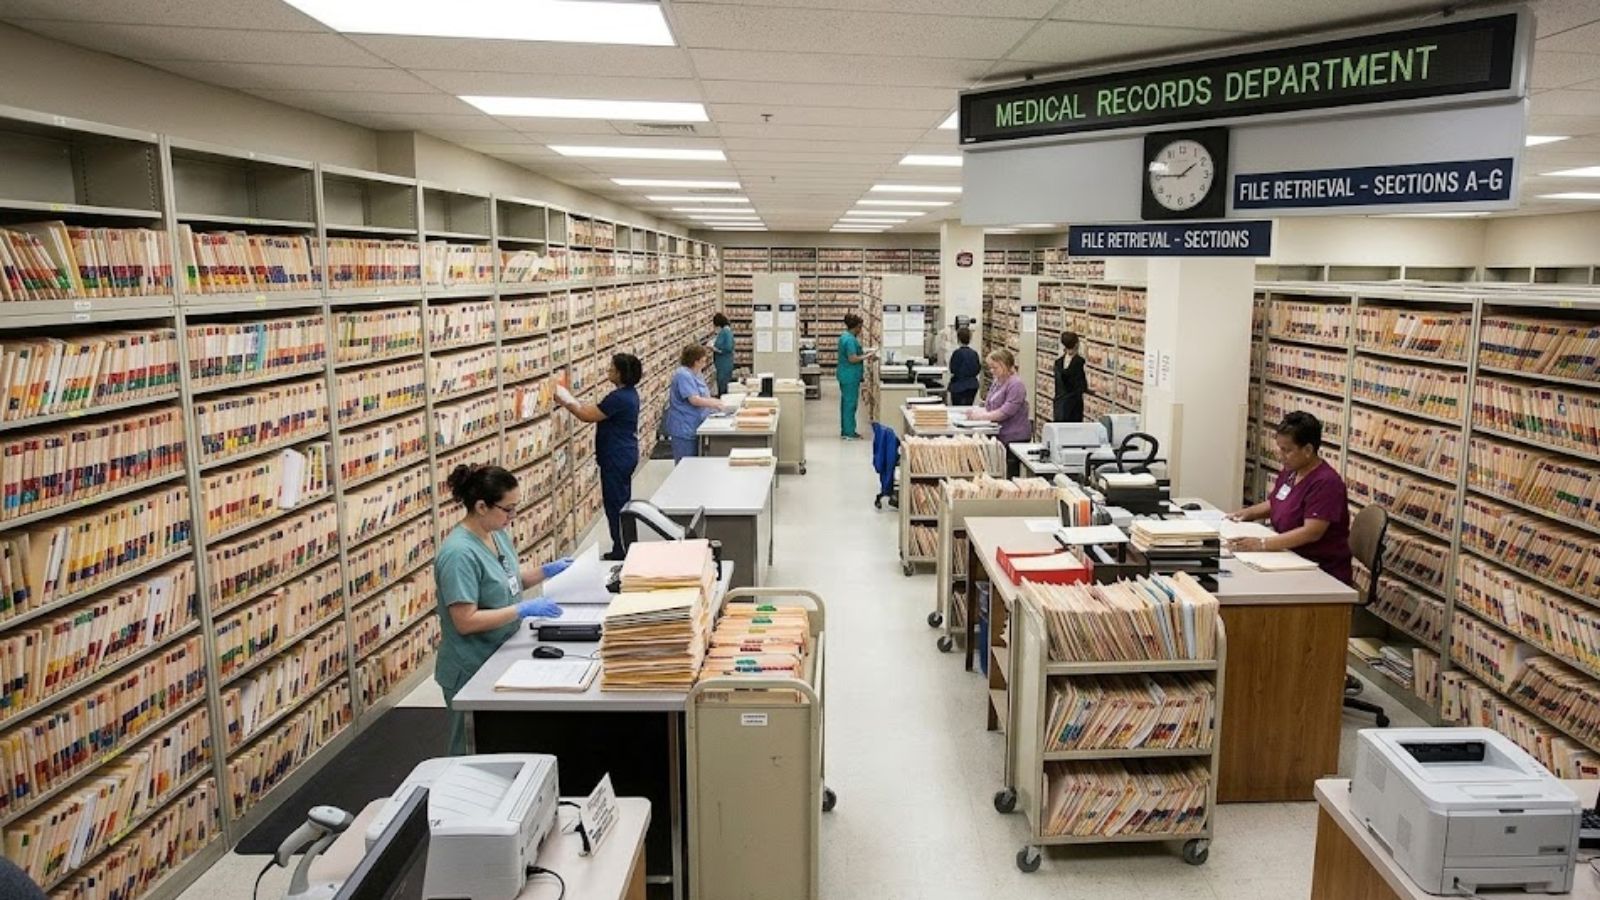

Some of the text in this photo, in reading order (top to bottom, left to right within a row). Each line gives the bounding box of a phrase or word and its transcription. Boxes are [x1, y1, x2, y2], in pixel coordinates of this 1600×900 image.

[996, 45, 1438, 127] MEDICAL RECORDS DEPARTMENT
[1239, 182, 1269, 201] FILE
[1274, 177, 1355, 200] RETRIEVAL
[1374, 171, 1459, 196] SECTIONS
[1081, 232, 1104, 249] FILE
[1107, 231, 1171, 249] RETRIEVAL
[1184, 230, 1250, 249] SECTIONS
